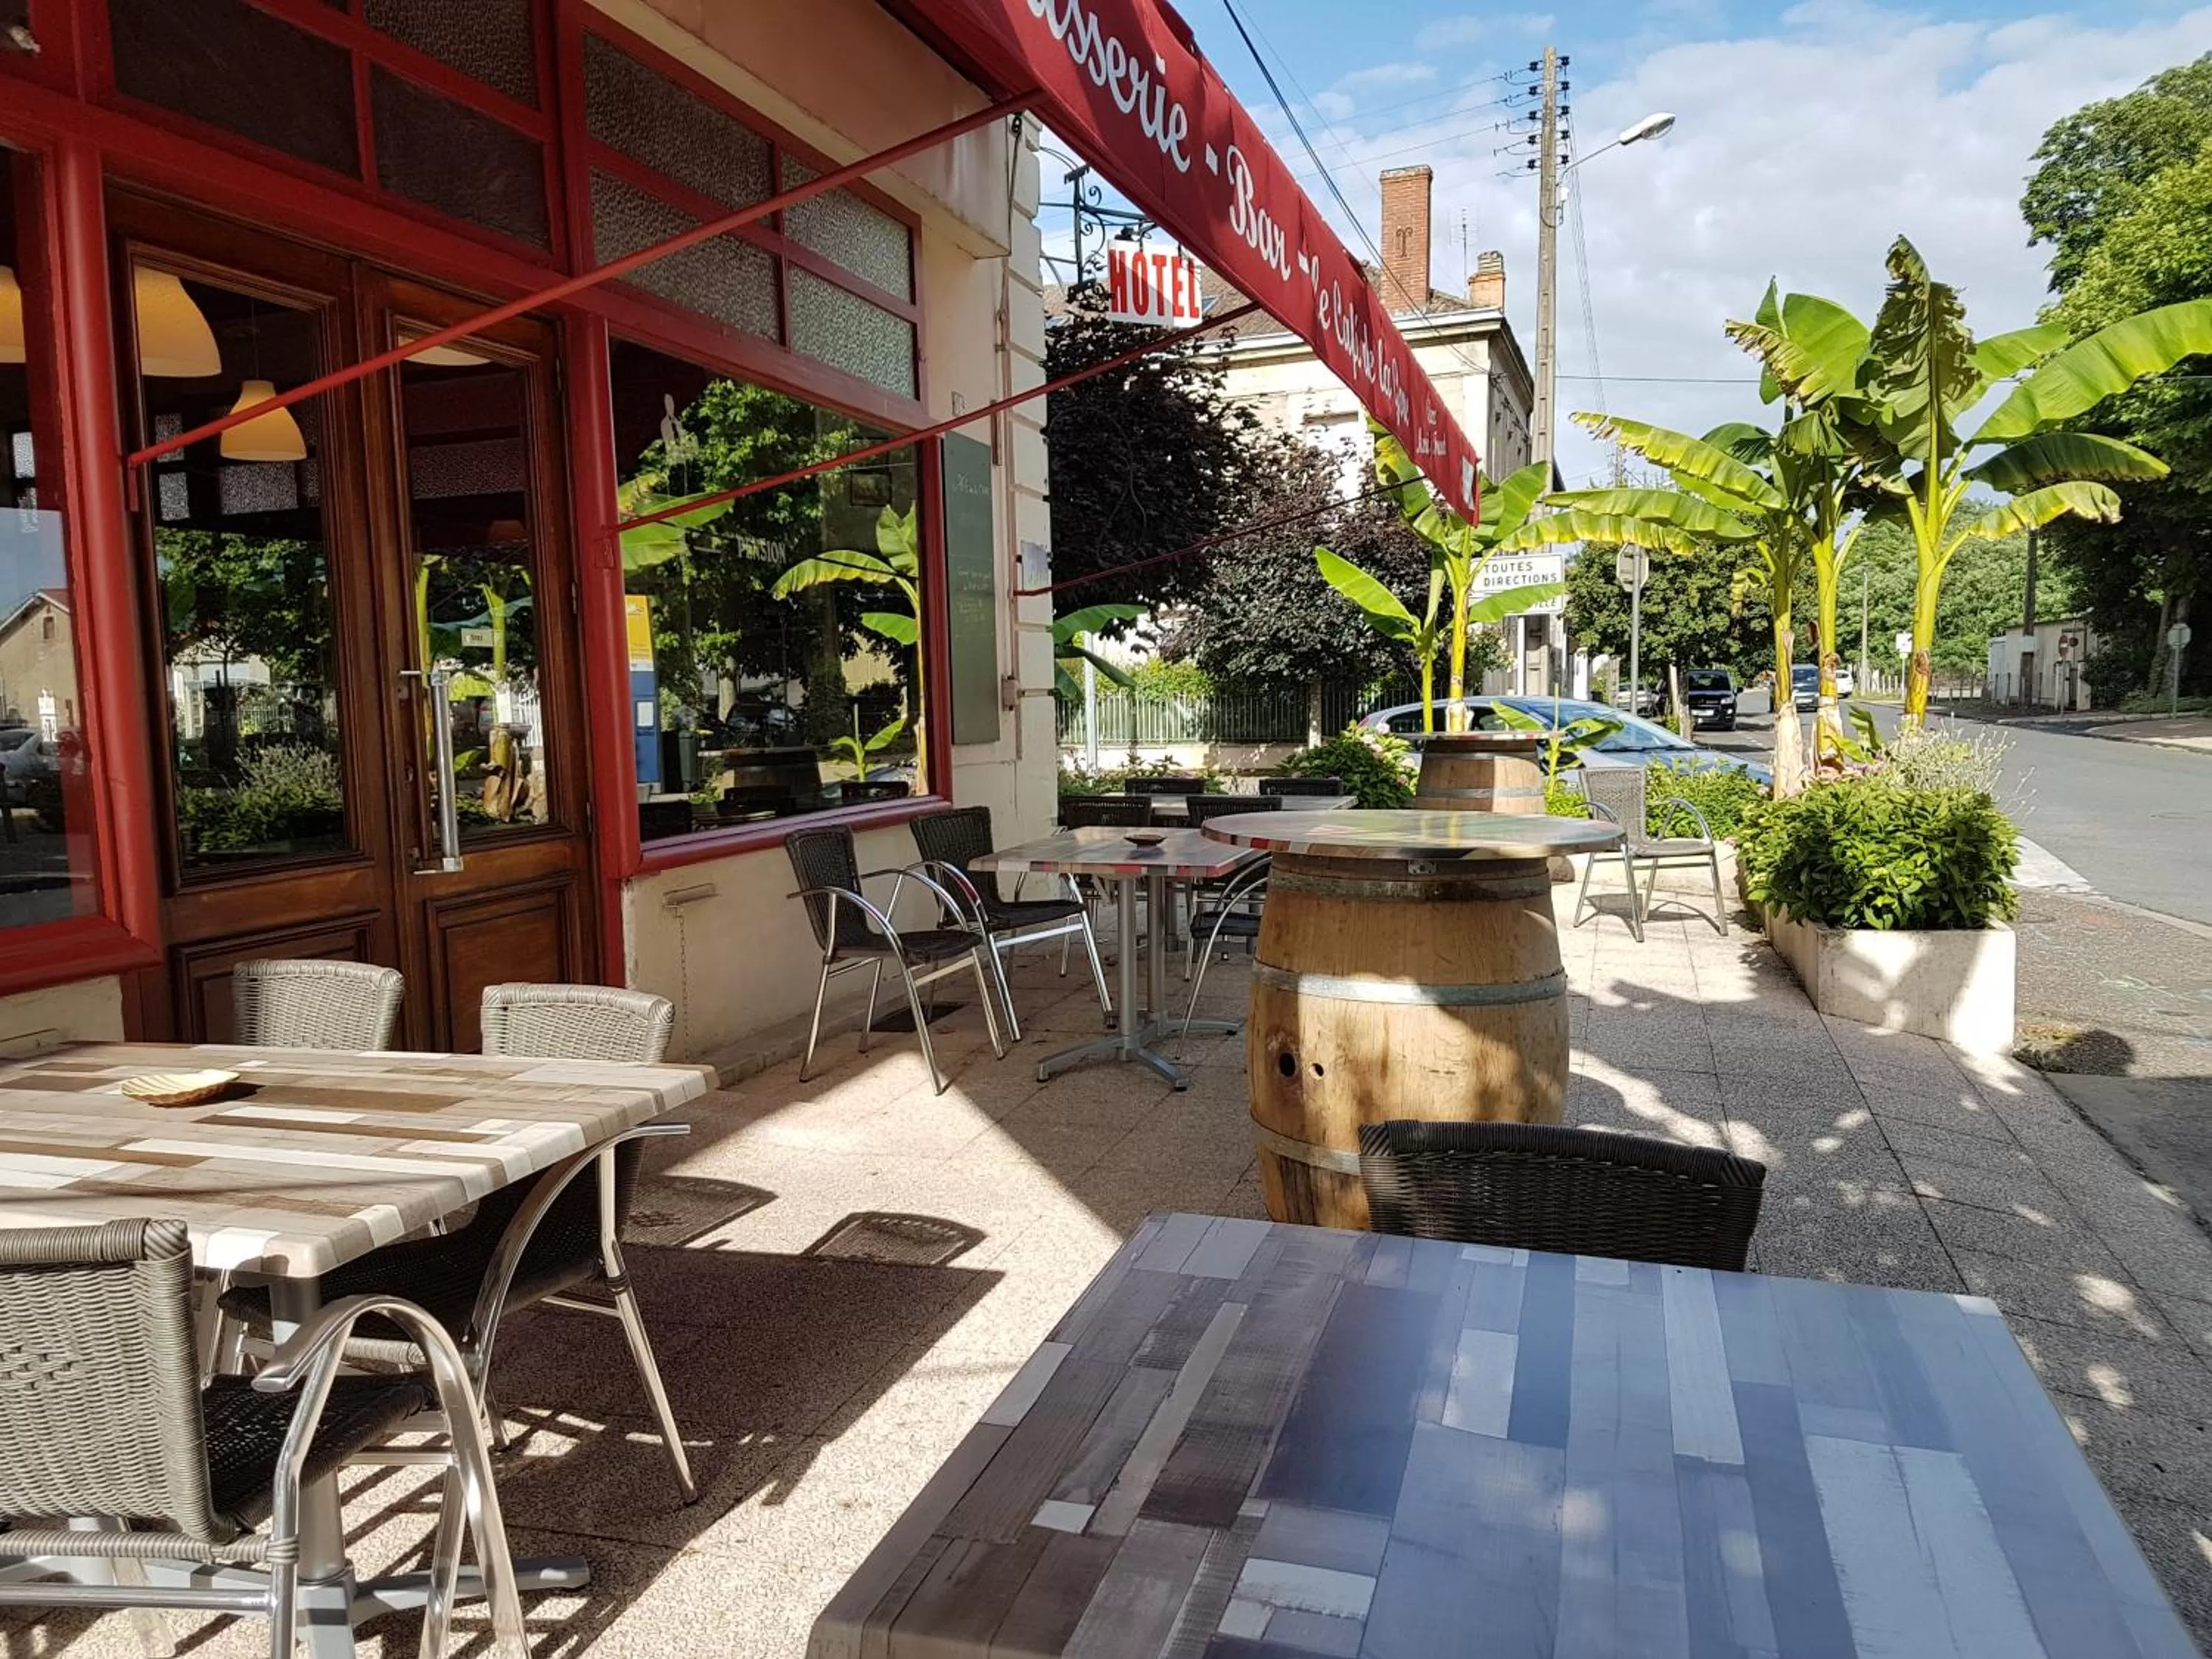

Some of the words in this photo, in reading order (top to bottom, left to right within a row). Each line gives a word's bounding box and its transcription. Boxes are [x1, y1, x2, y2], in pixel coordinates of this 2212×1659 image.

[1226, 145, 1291, 281] Bar
[1485, 561, 1533, 573] TOUTES
[1484, 573, 1557, 587] DIRECTIONS
